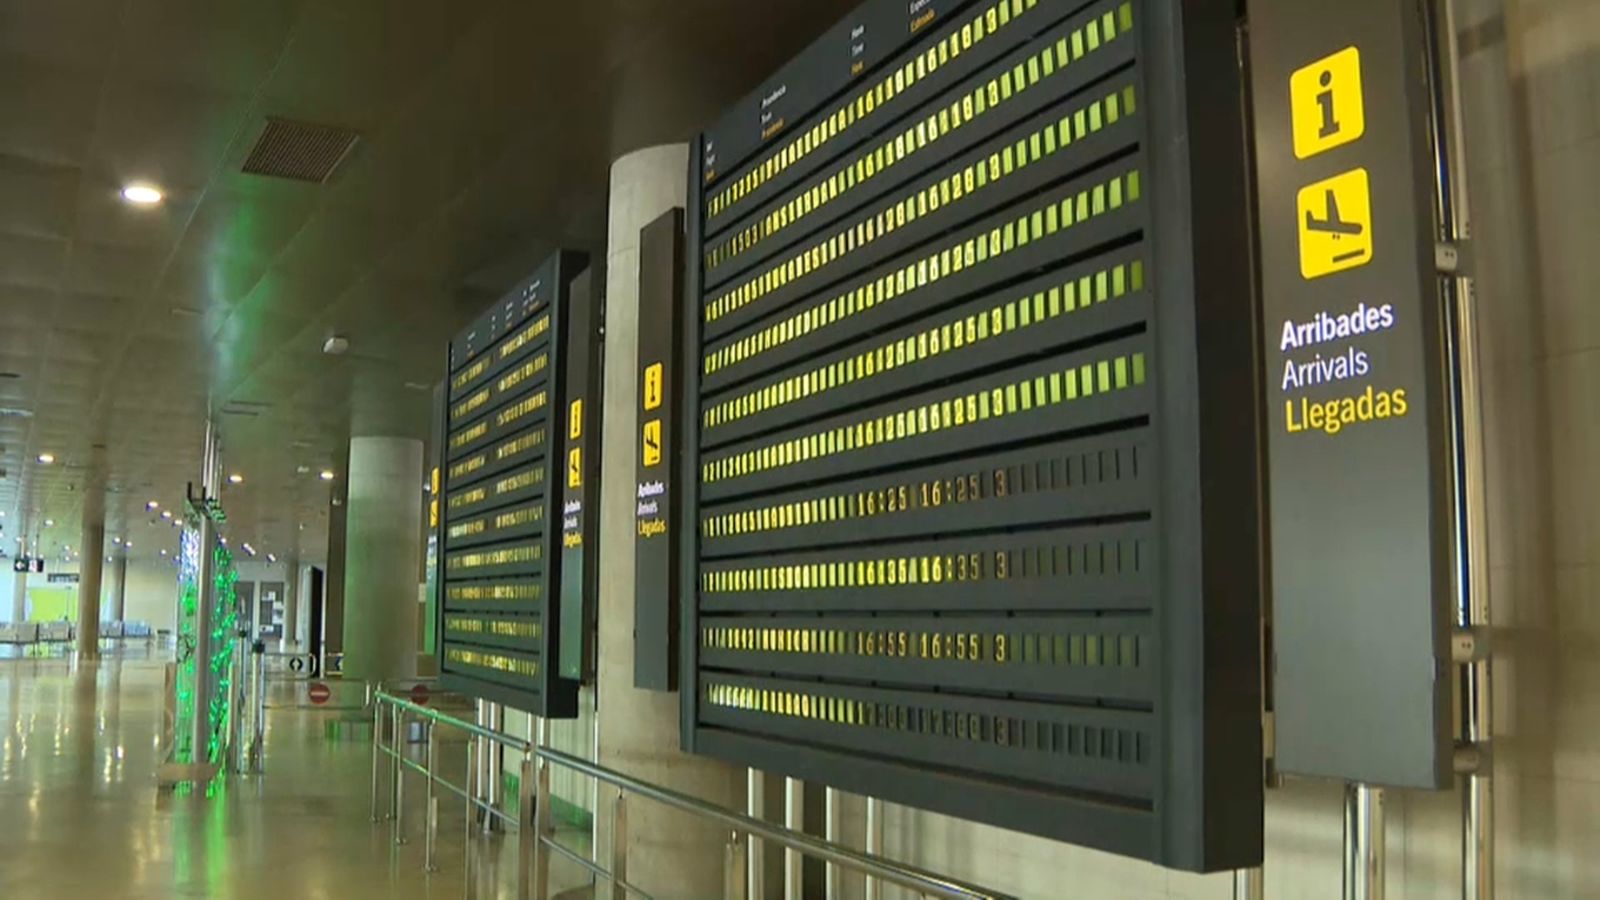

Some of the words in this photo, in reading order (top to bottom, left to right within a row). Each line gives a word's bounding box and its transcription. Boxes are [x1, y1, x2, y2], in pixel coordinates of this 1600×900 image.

[989, 152, 999, 182] 3
[918, 314, 975, 359] 16:25
[992, 306, 1002, 335] 3
[1280, 303, 1394, 351] Arribades
[1281, 348, 1369, 391] Arrivals
[918, 393, 976, 433] 16:25
[992, 387, 1002, 416] 3
[1284, 386, 1408, 435] Llegadas
[858, 485, 906, 517] 16:25
[922, 472, 978, 508] 16:25
[995, 468, 1004, 497] 3
[857, 558, 906, 586] 16:35
[921, 552, 978, 582] 16:35
[996, 550, 1005, 578] 3
[857, 631, 905, 656] 16:55
[921, 633, 977, 660] 16:55
[995, 635, 1004, 662] 3
